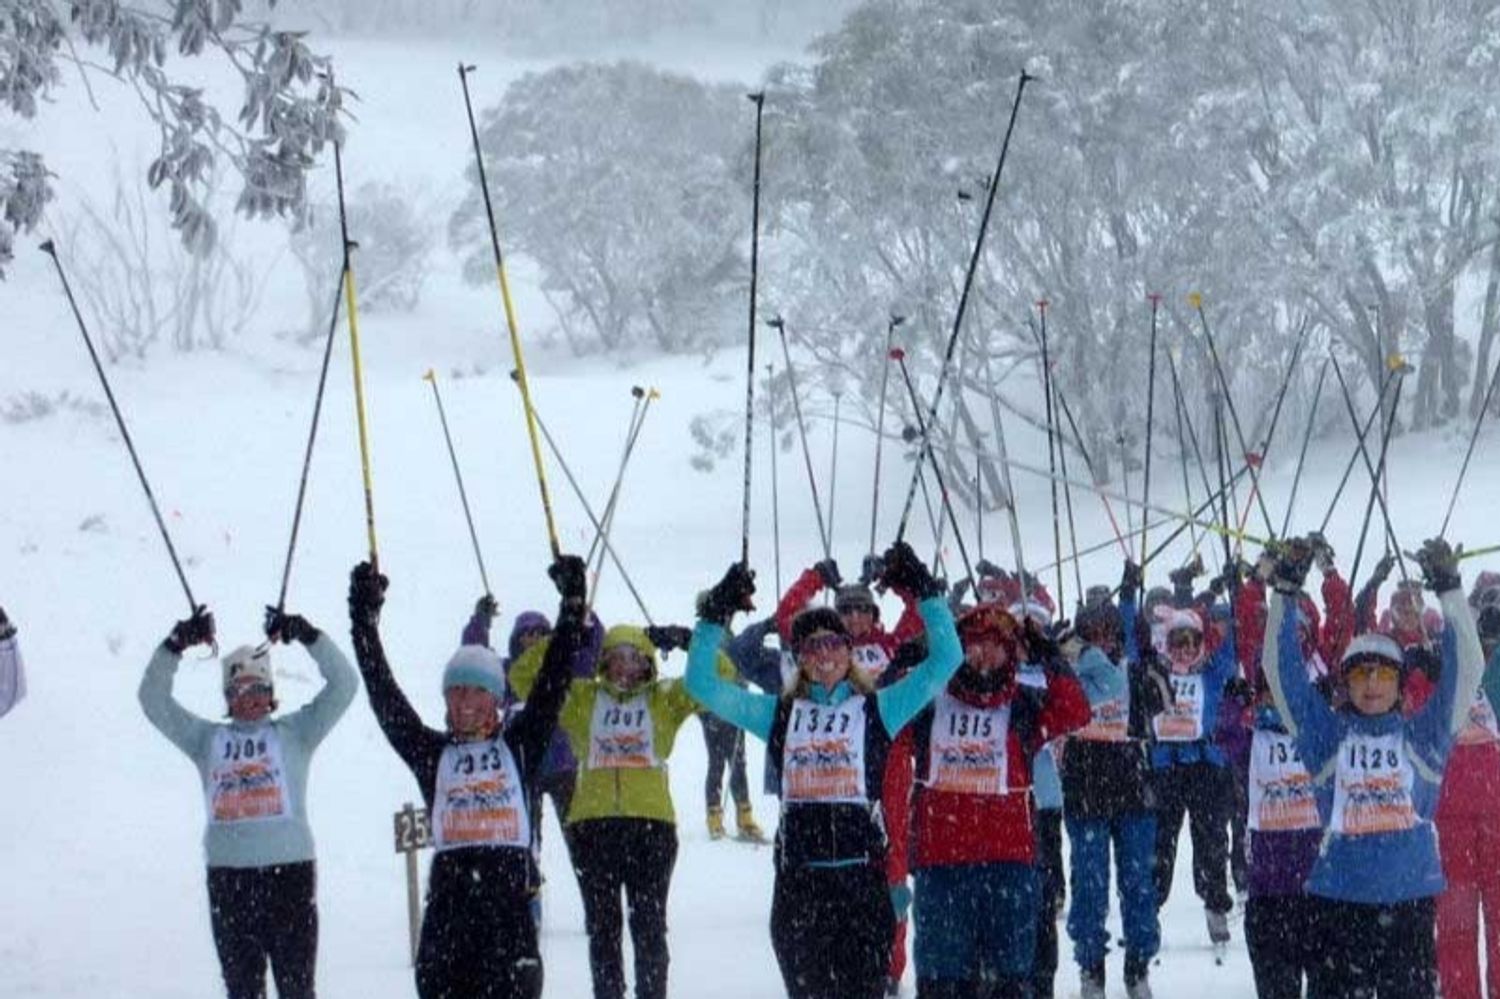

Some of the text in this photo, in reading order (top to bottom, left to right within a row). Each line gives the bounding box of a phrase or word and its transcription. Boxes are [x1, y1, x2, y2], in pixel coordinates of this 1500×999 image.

[793, 708, 849, 733] 1327
[950, 712, 992, 737] 1315
[401, 811, 427, 848] 25
